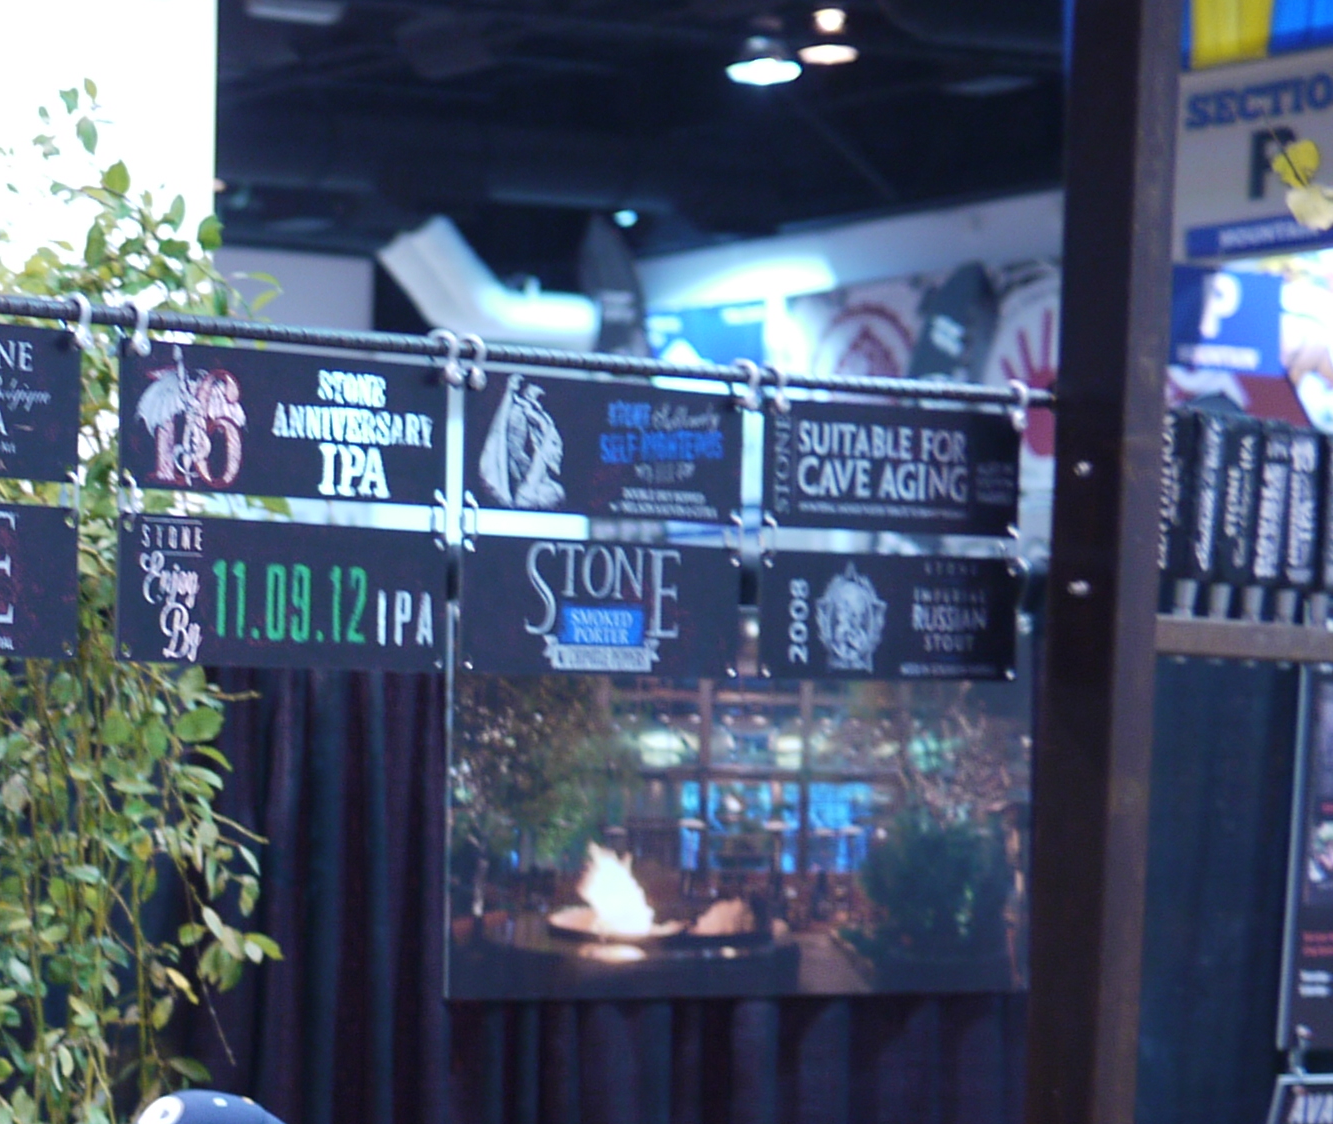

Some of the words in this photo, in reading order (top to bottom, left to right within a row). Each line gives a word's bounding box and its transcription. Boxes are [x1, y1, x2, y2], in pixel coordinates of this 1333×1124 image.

[316, 369, 387, 408] STONE
[271, 402, 434, 449] ANNIVERSARY
[797, 419, 912, 461] SUITABLE
[919, 426, 967, 464] FOR
[316, 442, 392, 499] IPA
[797, 455, 871, 498] CAVE
[877, 462, 968, 504] AGING
[140, 523, 203, 551] STONE
[139, 550, 199, 609] Enjoy
[212, 558, 369, 645] 11.09.12
[376, 588, 434, 648] IPA
[523, 540, 683, 640] STONE
[787, 578, 810, 664] 2008
